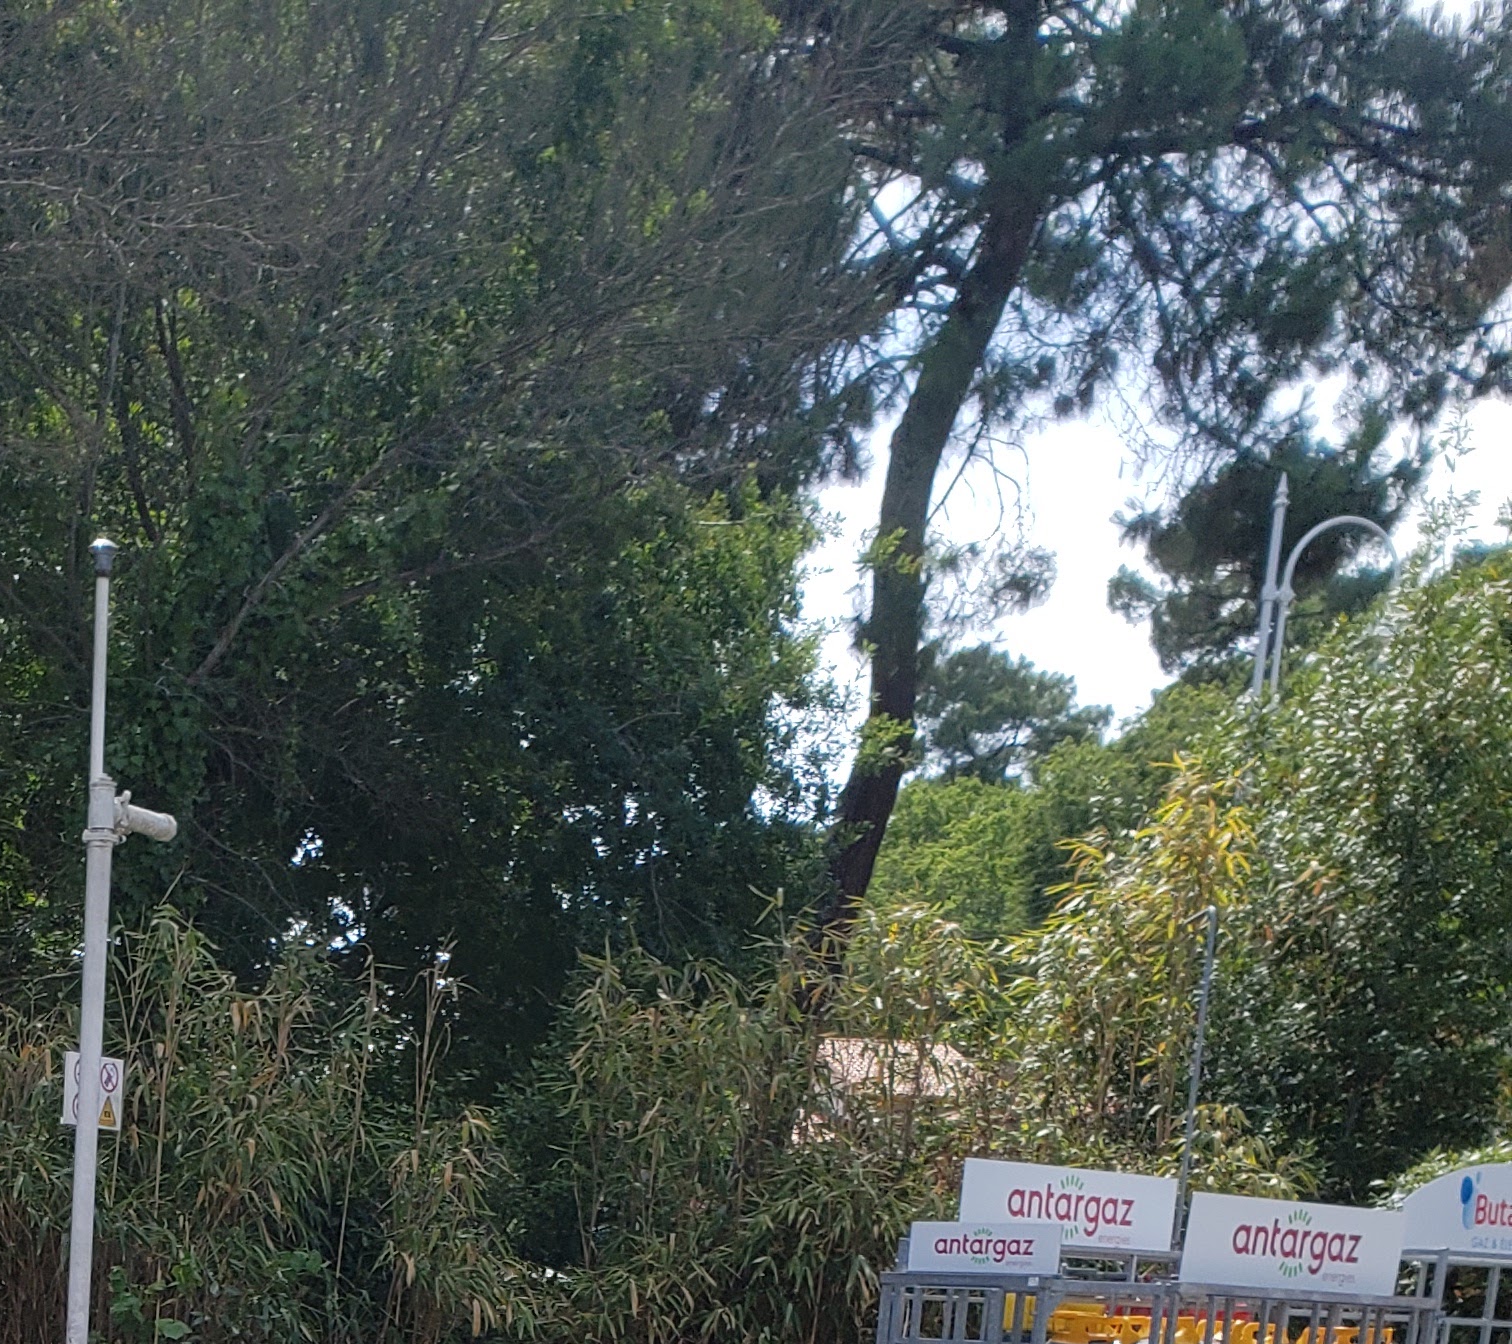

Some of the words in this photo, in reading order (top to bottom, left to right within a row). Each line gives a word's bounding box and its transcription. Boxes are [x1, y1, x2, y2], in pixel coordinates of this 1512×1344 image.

[1007, 1183, 1135, 1236] antargaz
[934, 1233, 1036, 1263] antargaz
[1232, 1218, 1363, 1275] antargaz
